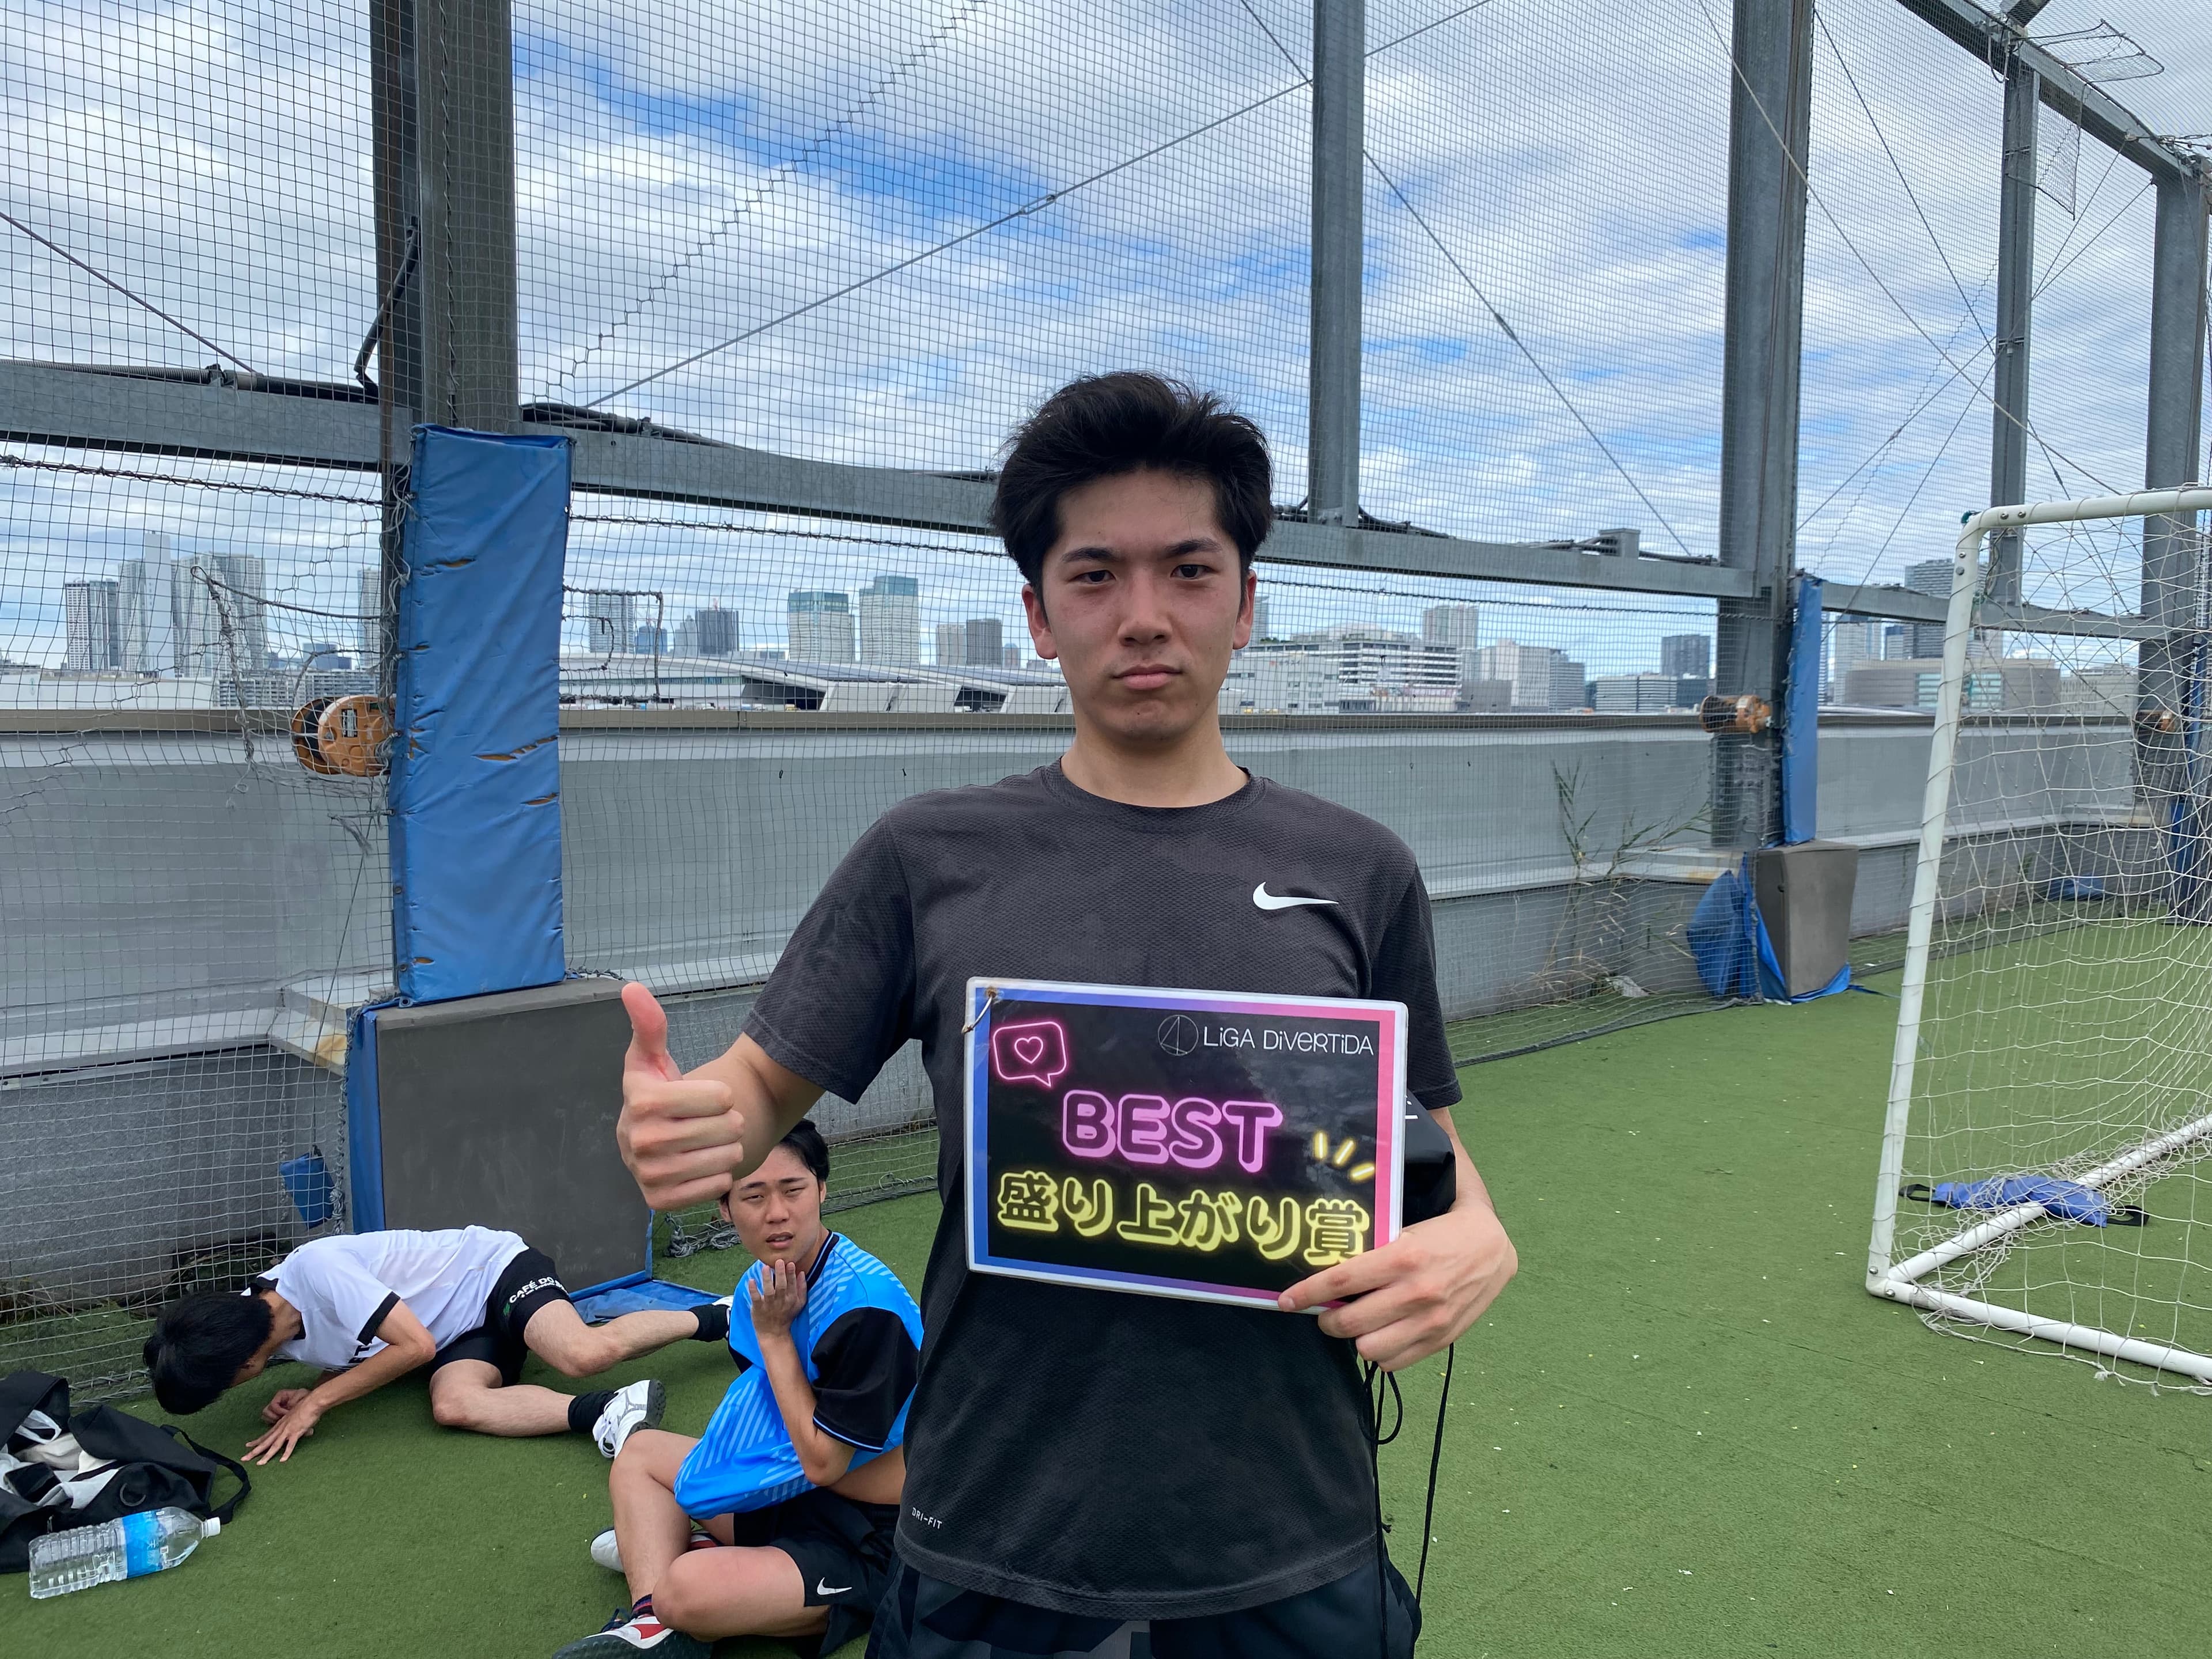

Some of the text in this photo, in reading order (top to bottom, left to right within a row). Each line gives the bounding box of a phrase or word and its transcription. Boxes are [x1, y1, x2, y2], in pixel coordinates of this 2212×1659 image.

[1062, 1089, 1283, 1173] BEST
[997, 1169, 1369, 1266] 盛り上がり賞
[509, 1280, 537, 1303] CAFÉ
[911, 1507, 942, 1529] DRI-FIT
